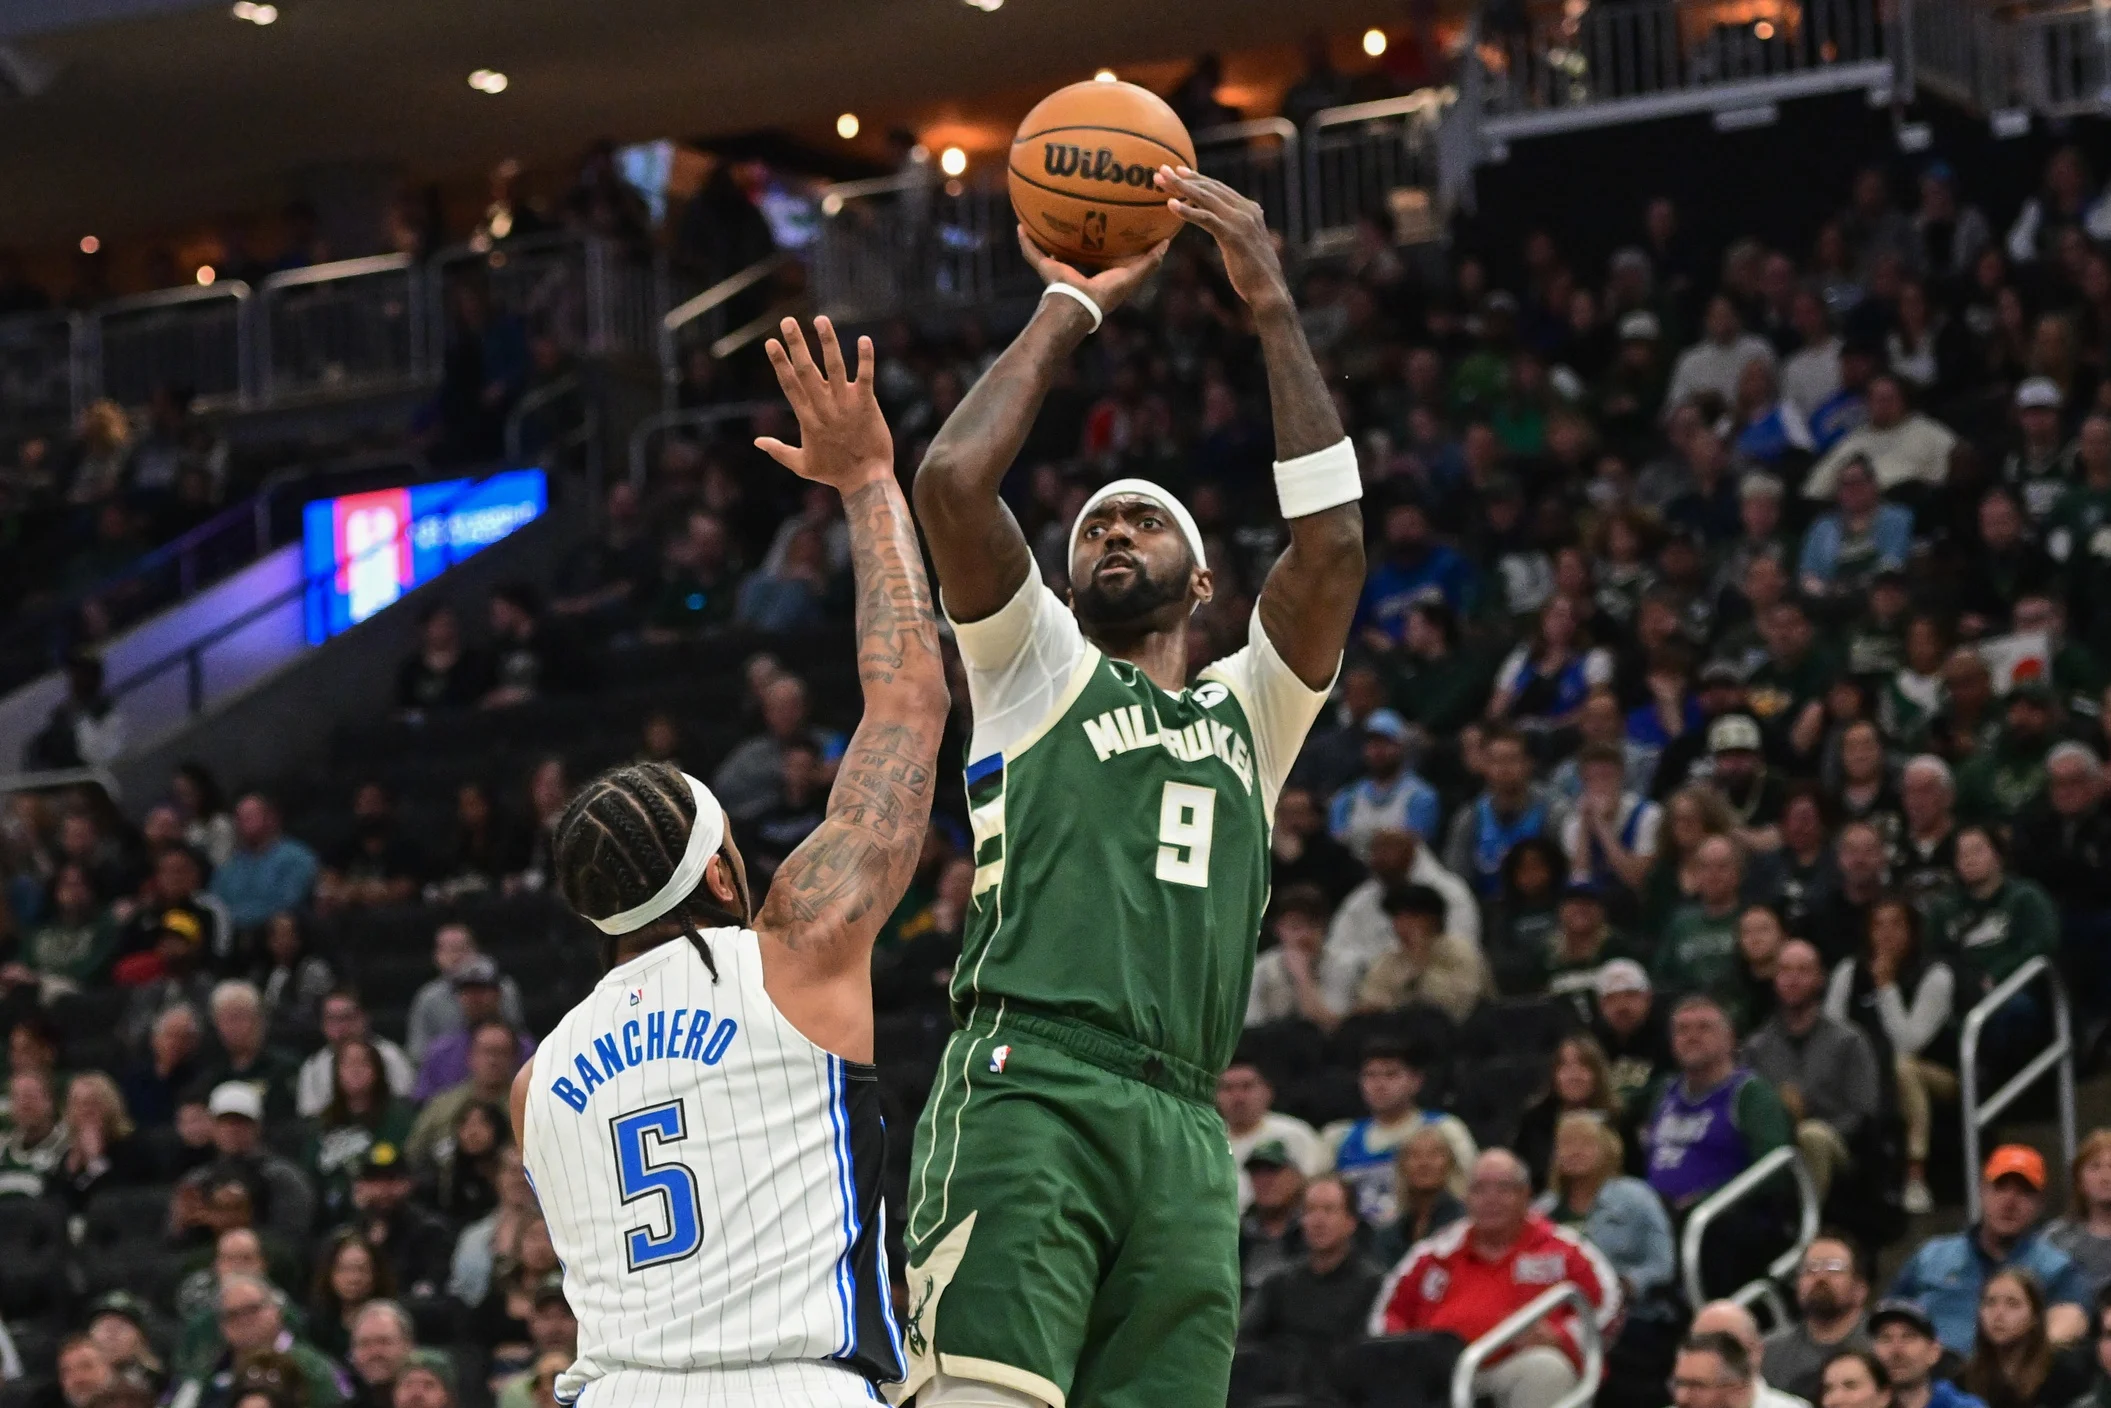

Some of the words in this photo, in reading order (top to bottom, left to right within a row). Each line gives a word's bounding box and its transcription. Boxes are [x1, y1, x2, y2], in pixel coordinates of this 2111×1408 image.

[1082, 704, 1254, 797] MILAUKE
[1155, 780, 1217, 889] 9
[550, 1008, 738, 1115] BANCHERO
[608, 1097, 705, 1274] 5
